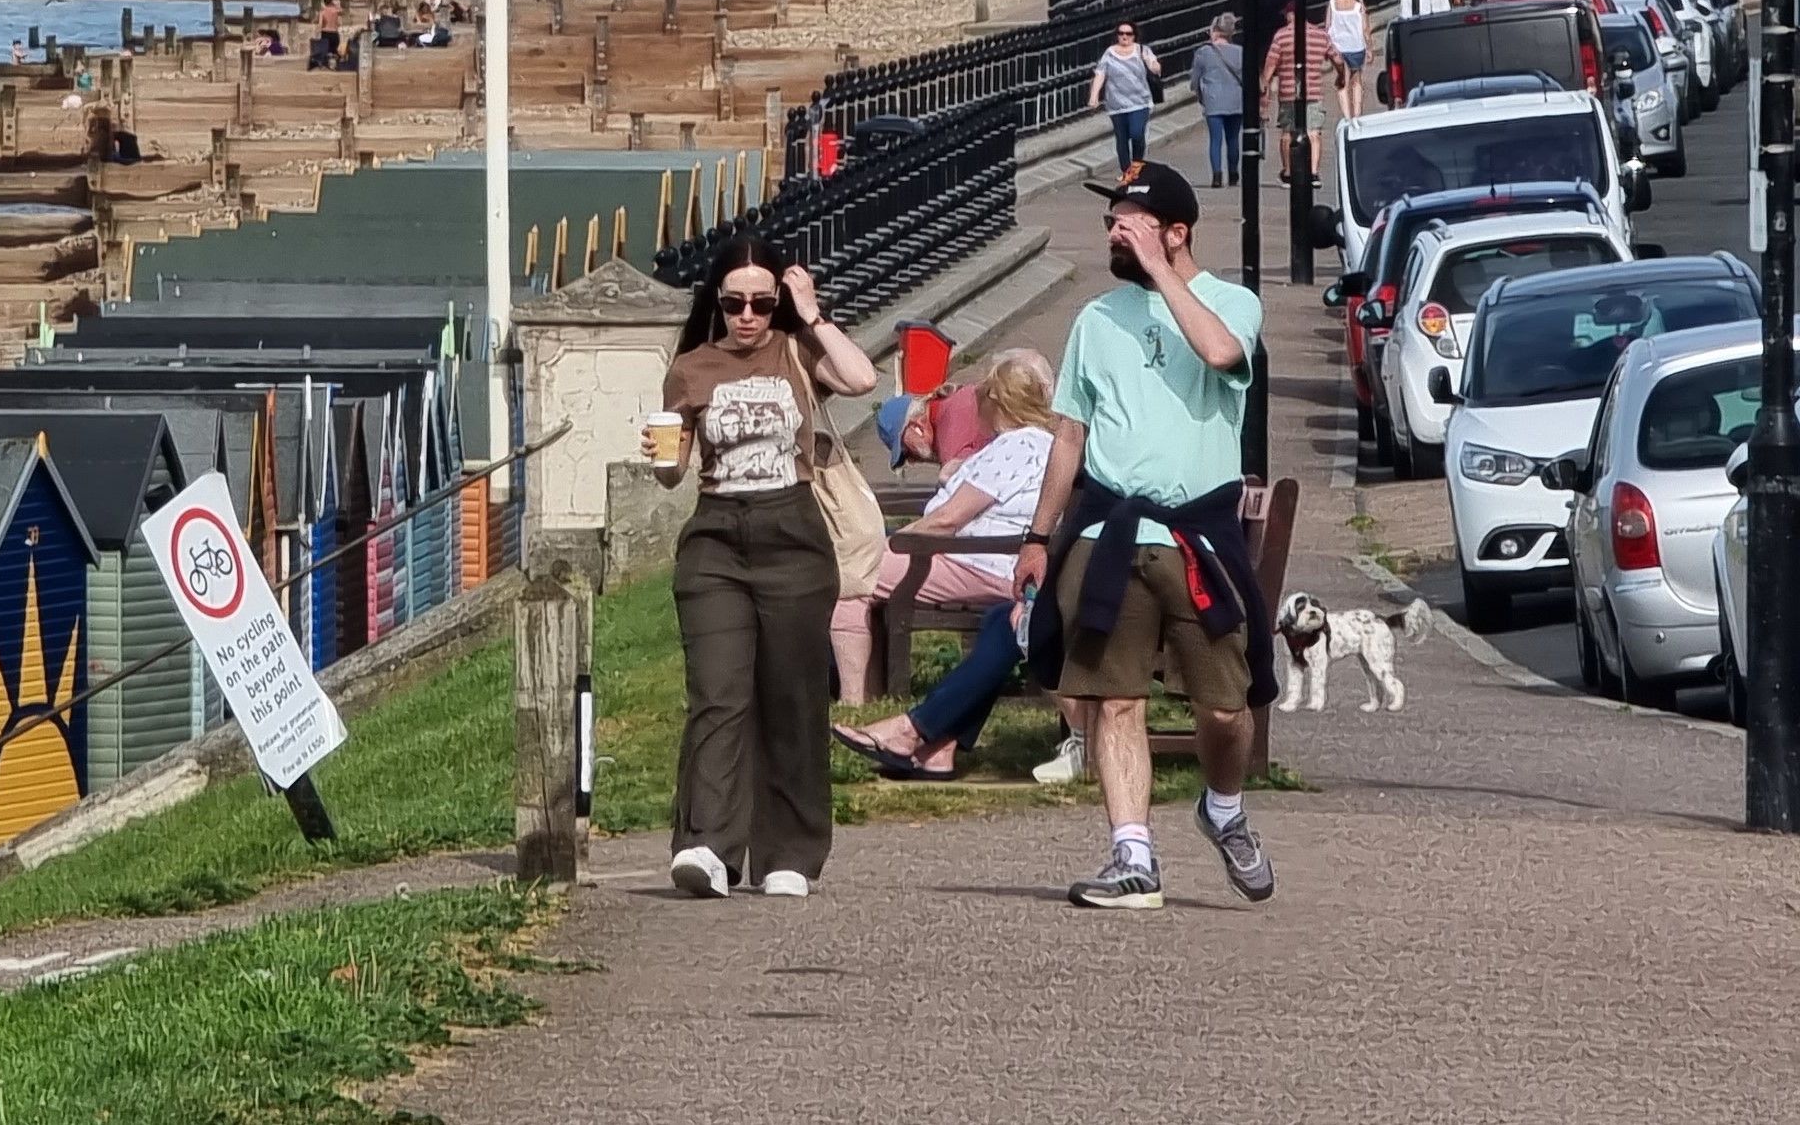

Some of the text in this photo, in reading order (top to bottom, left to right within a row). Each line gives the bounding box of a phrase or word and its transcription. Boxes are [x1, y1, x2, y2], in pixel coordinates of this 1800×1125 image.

[216, 613, 276, 666] No cycling
[225, 631, 288, 688] on the path
[245, 656, 286, 699] beyond
[250, 673, 303, 724] this point
